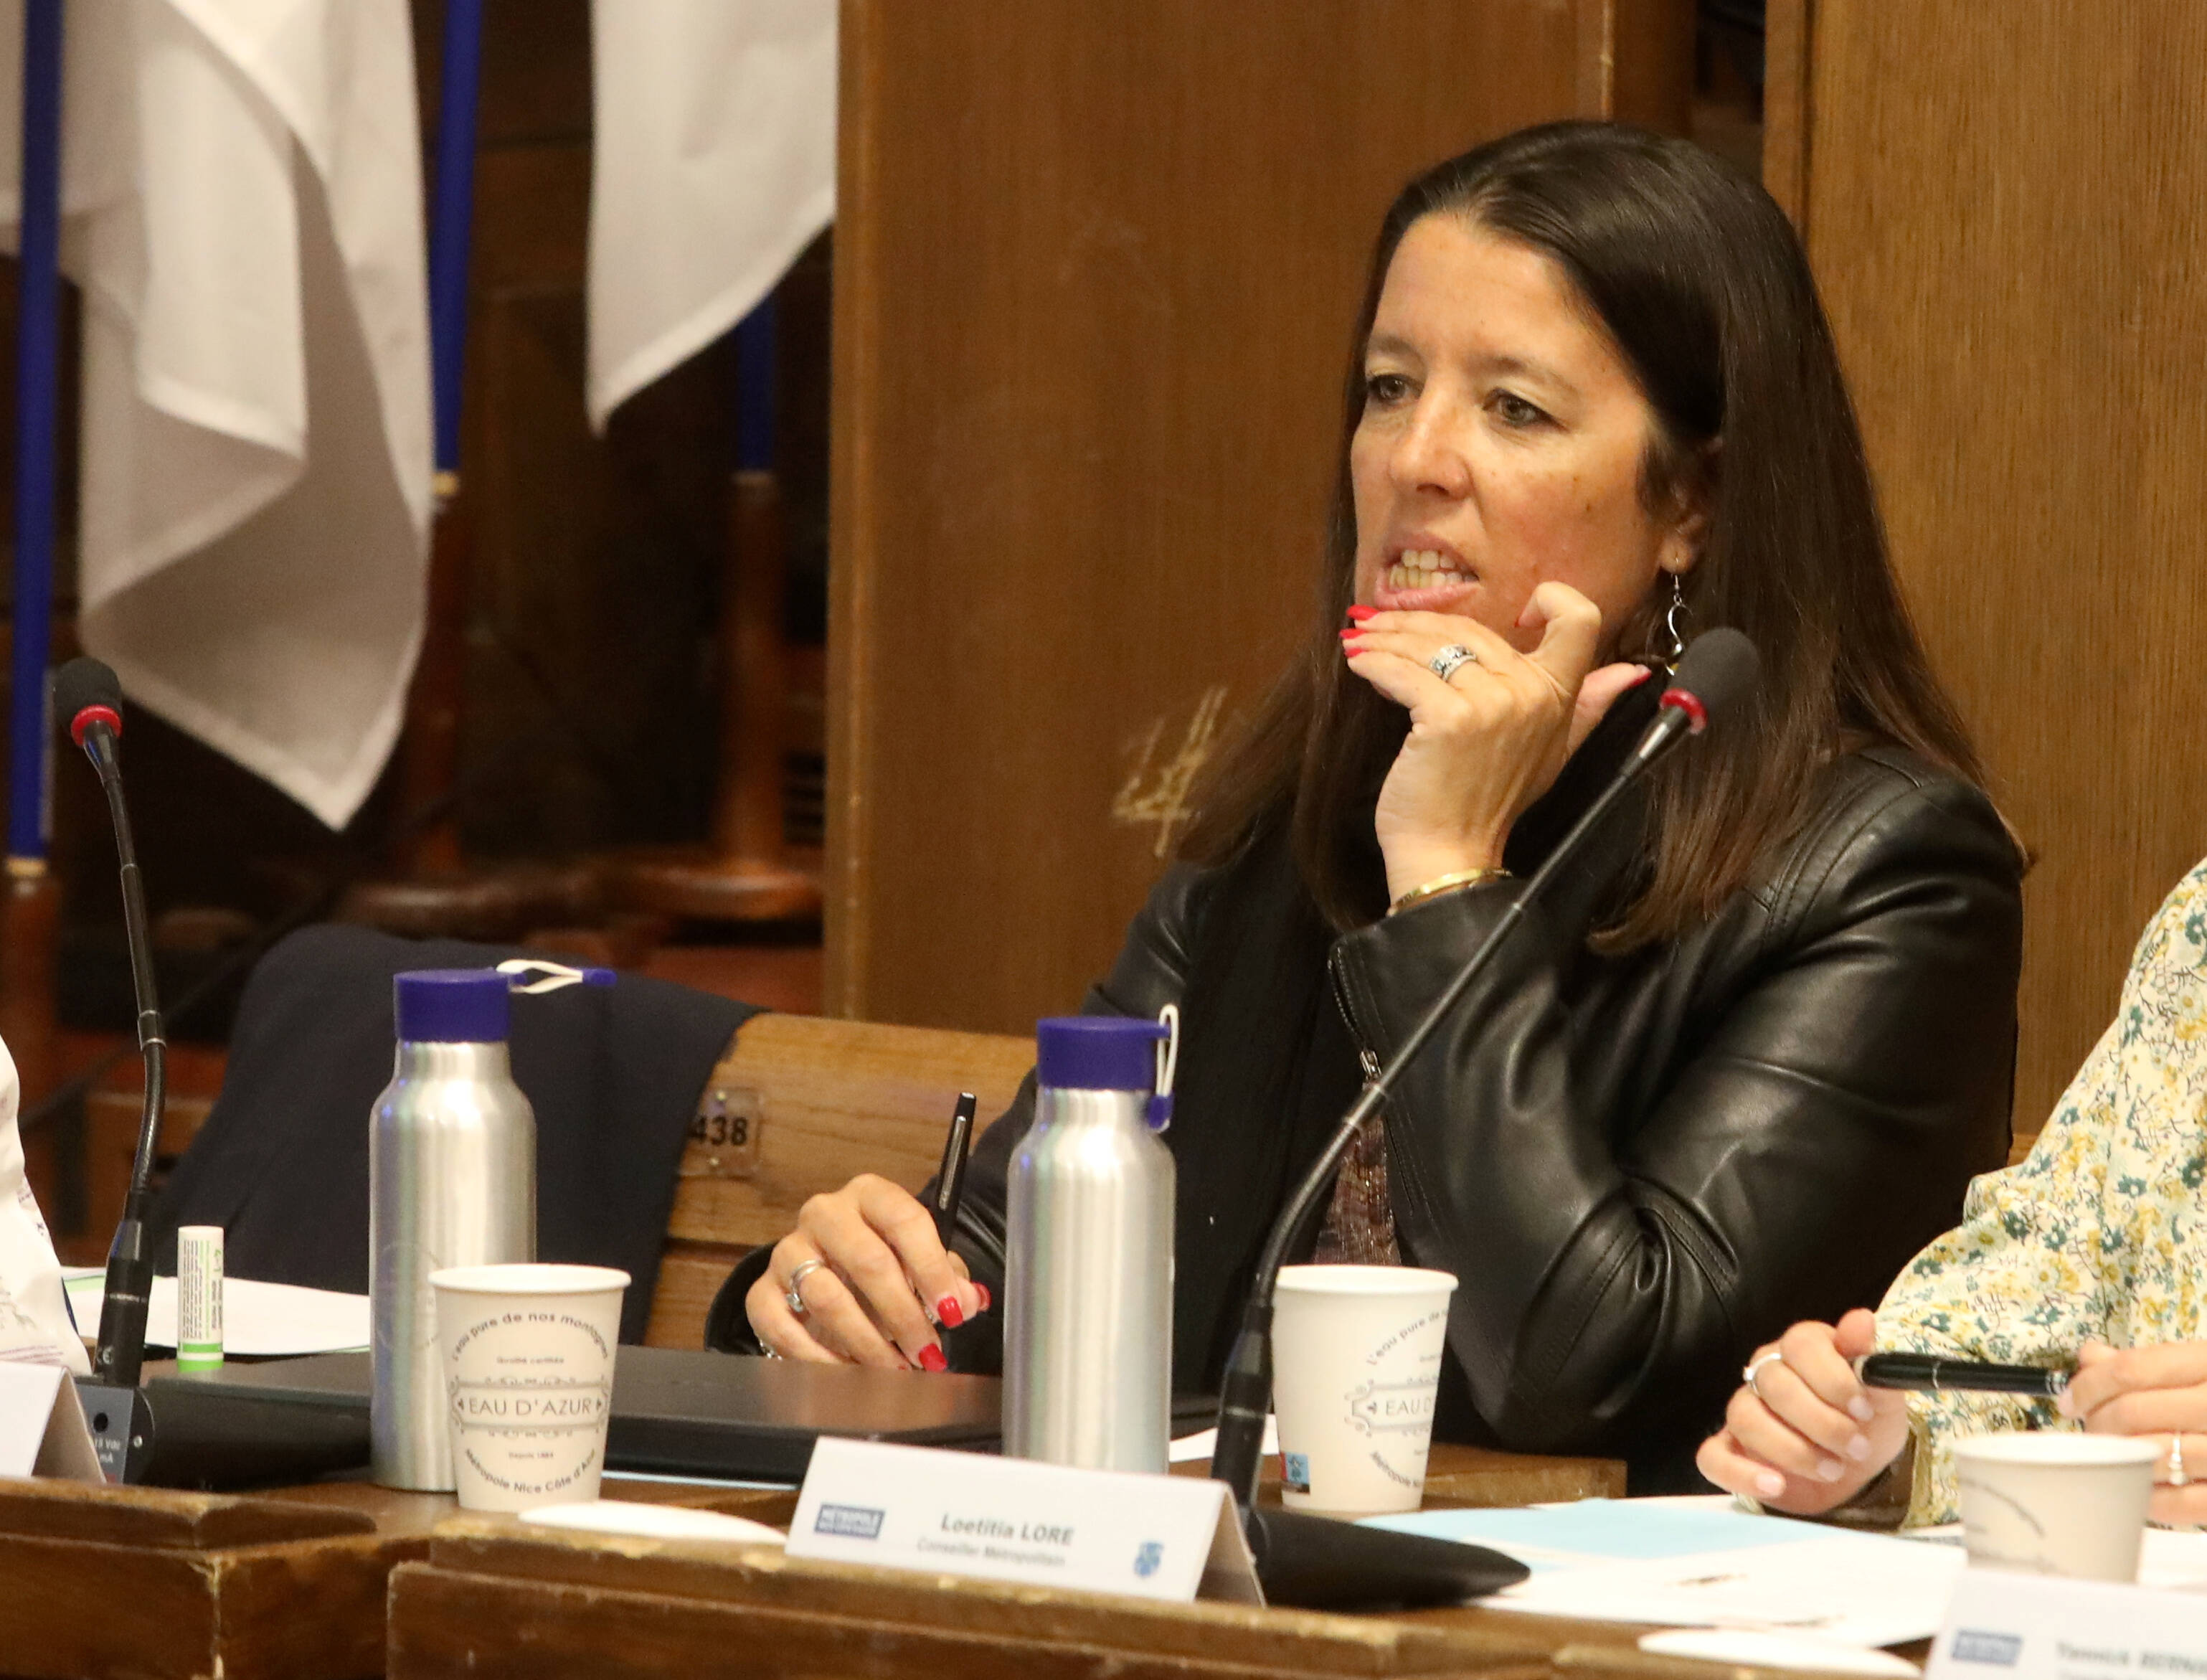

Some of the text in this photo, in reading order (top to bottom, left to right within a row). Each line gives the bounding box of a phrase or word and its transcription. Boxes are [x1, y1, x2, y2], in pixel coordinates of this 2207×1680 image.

[686, 1115, 748, 1146] 438
[470, 1318, 498, 1339] pure
[502, 1313, 521, 1323] de
[528, 1313, 555, 1322] nos
[1366, 1336, 1398, 1366] L'eau
[1399, 1318, 1425, 1341] pure
[468, 1397, 592, 1416] EAU D'AZUR
[1386, 1399, 1421, 1416] EAU
[514, 1481, 542, 1494] Nice
[1021, 1521, 1075, 1547] LORE
